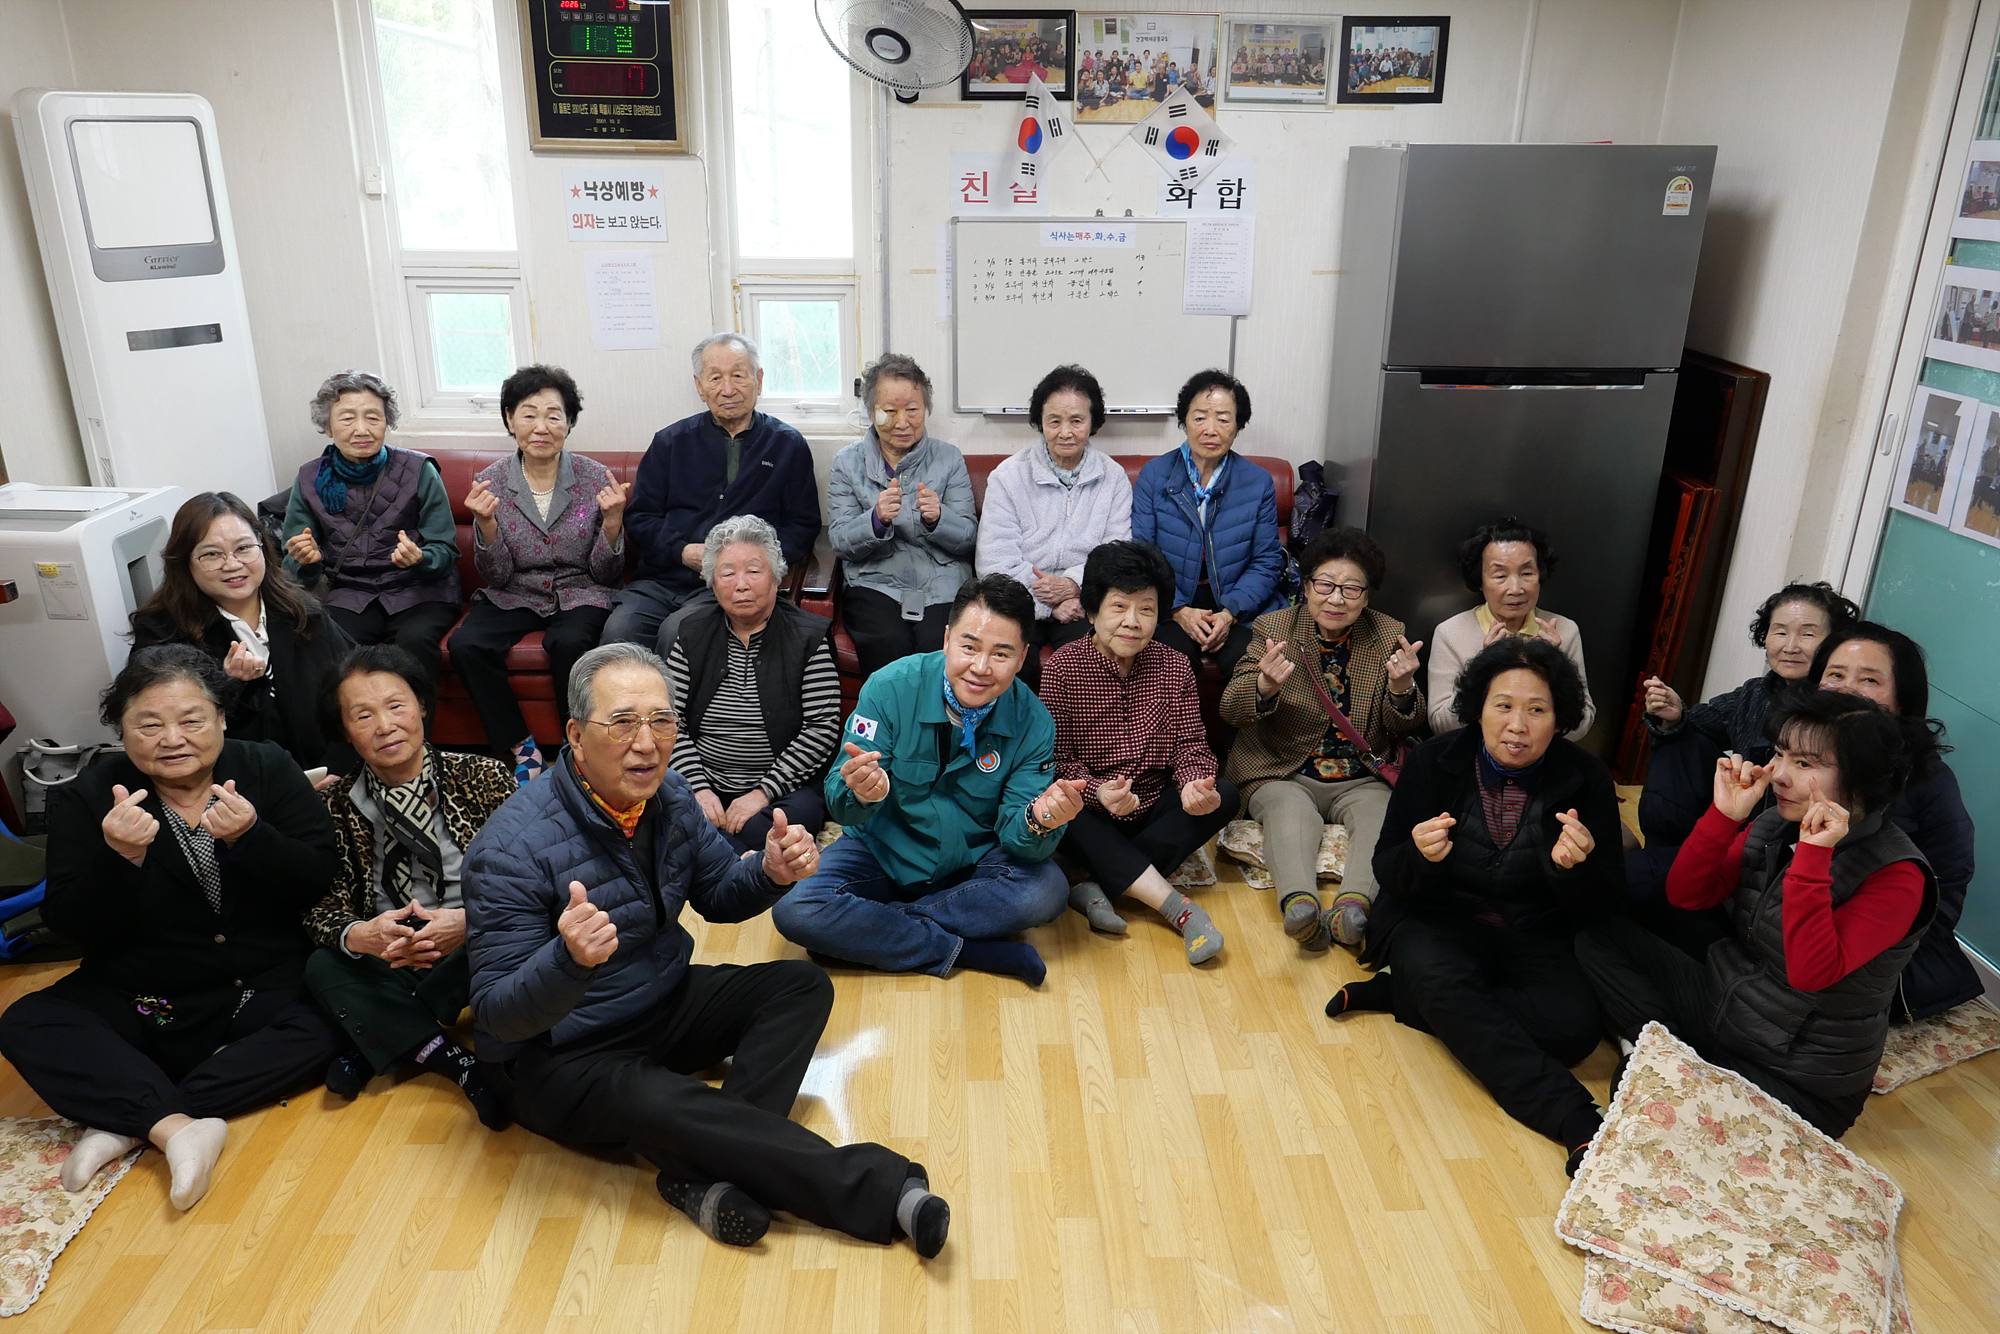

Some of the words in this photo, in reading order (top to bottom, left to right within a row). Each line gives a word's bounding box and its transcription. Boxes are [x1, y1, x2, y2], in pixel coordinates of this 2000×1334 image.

[583, 180, 645, 202] 낙상예방
[572, 213, 605, 229] 의자는
[608, 215, 627, 228] 보고
[630, 215, 662, 229] 앉는다.
[144, 255, 179, 264] Carrier
[421, 1036, 441, 1058] WAY
